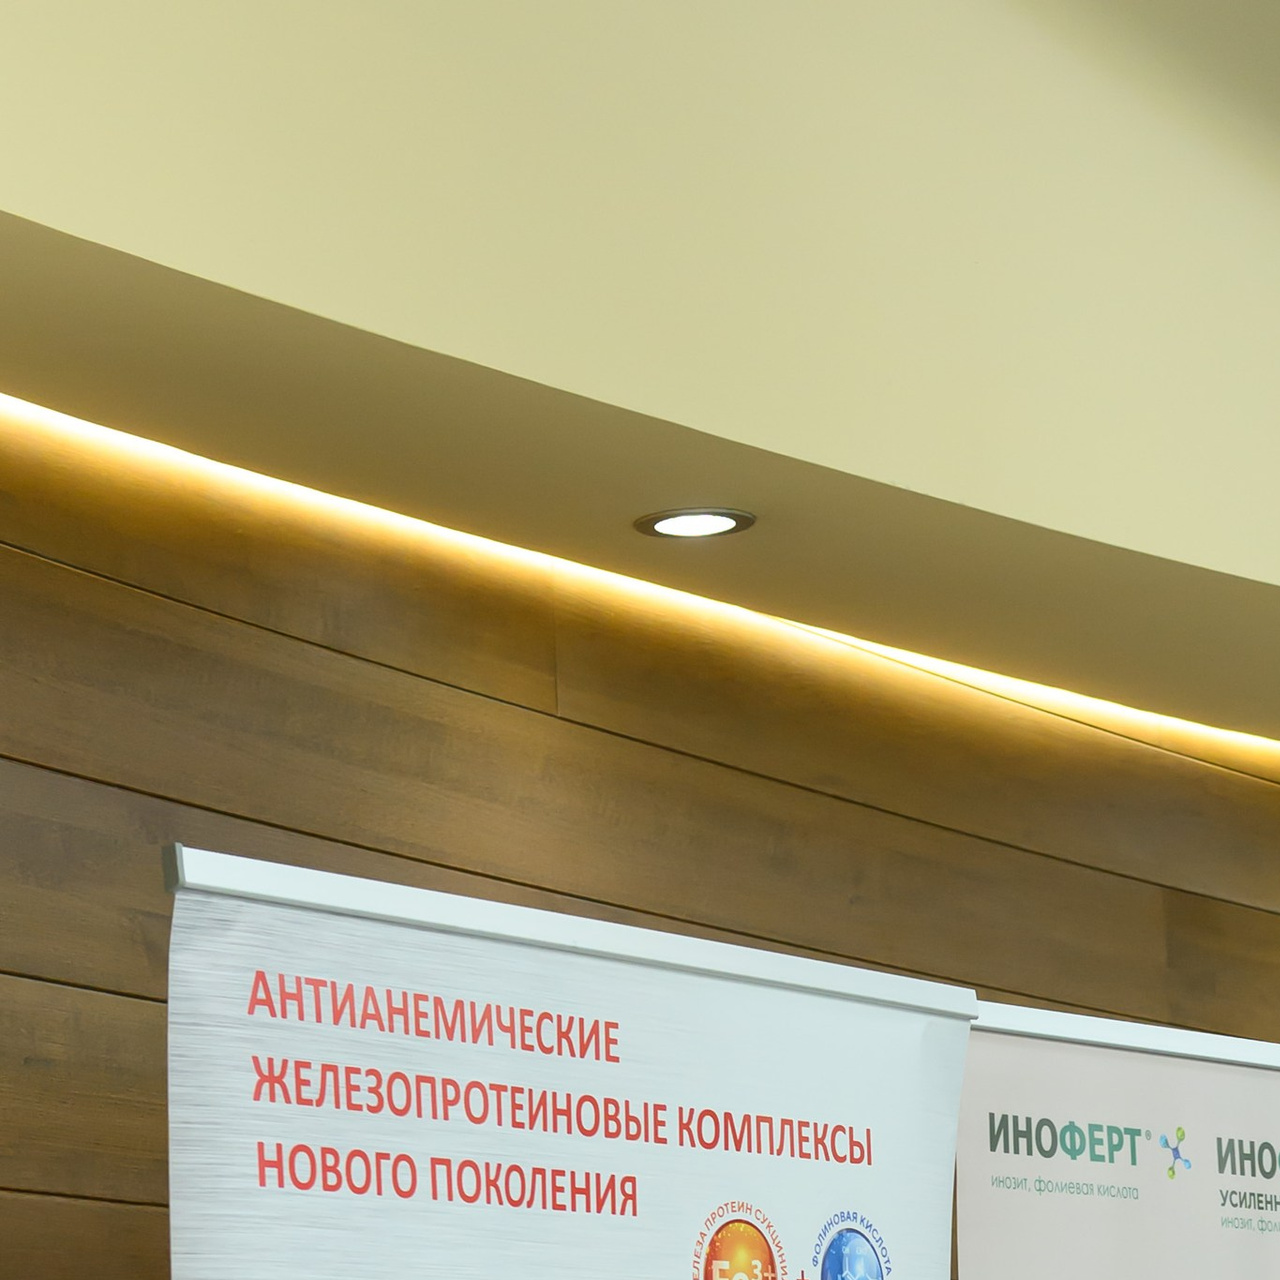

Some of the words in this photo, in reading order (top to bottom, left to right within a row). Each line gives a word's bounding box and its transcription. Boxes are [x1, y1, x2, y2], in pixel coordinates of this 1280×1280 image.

[247, 969, 620, 1063] АНТИАНЕМИЧЕСКИЕ
[251, 1055, 668, 1145] ЖЕЛЕЗОПРОТЕИНОВЫЕ
[677, 1106, 873, 1166] КОМПЛЕКСЫ
[256, 1140, 417, 1199] НОВОГО
[431, 1157, 638, 1217] ПОКОЛЕНИЯ
[991, 1174, 1031, 1192] инозит,
[1034, 1175, 1094, 1196] фолиевая
[1097, 1184, 1139, 1200] кислота
[704, 1200, 753, 1232] ПРОТЕИН
[812, 1210, 858, 1267] ФОЛИНОВАЯ
[859, 1214, 892, 1276] КИСЛОТА
